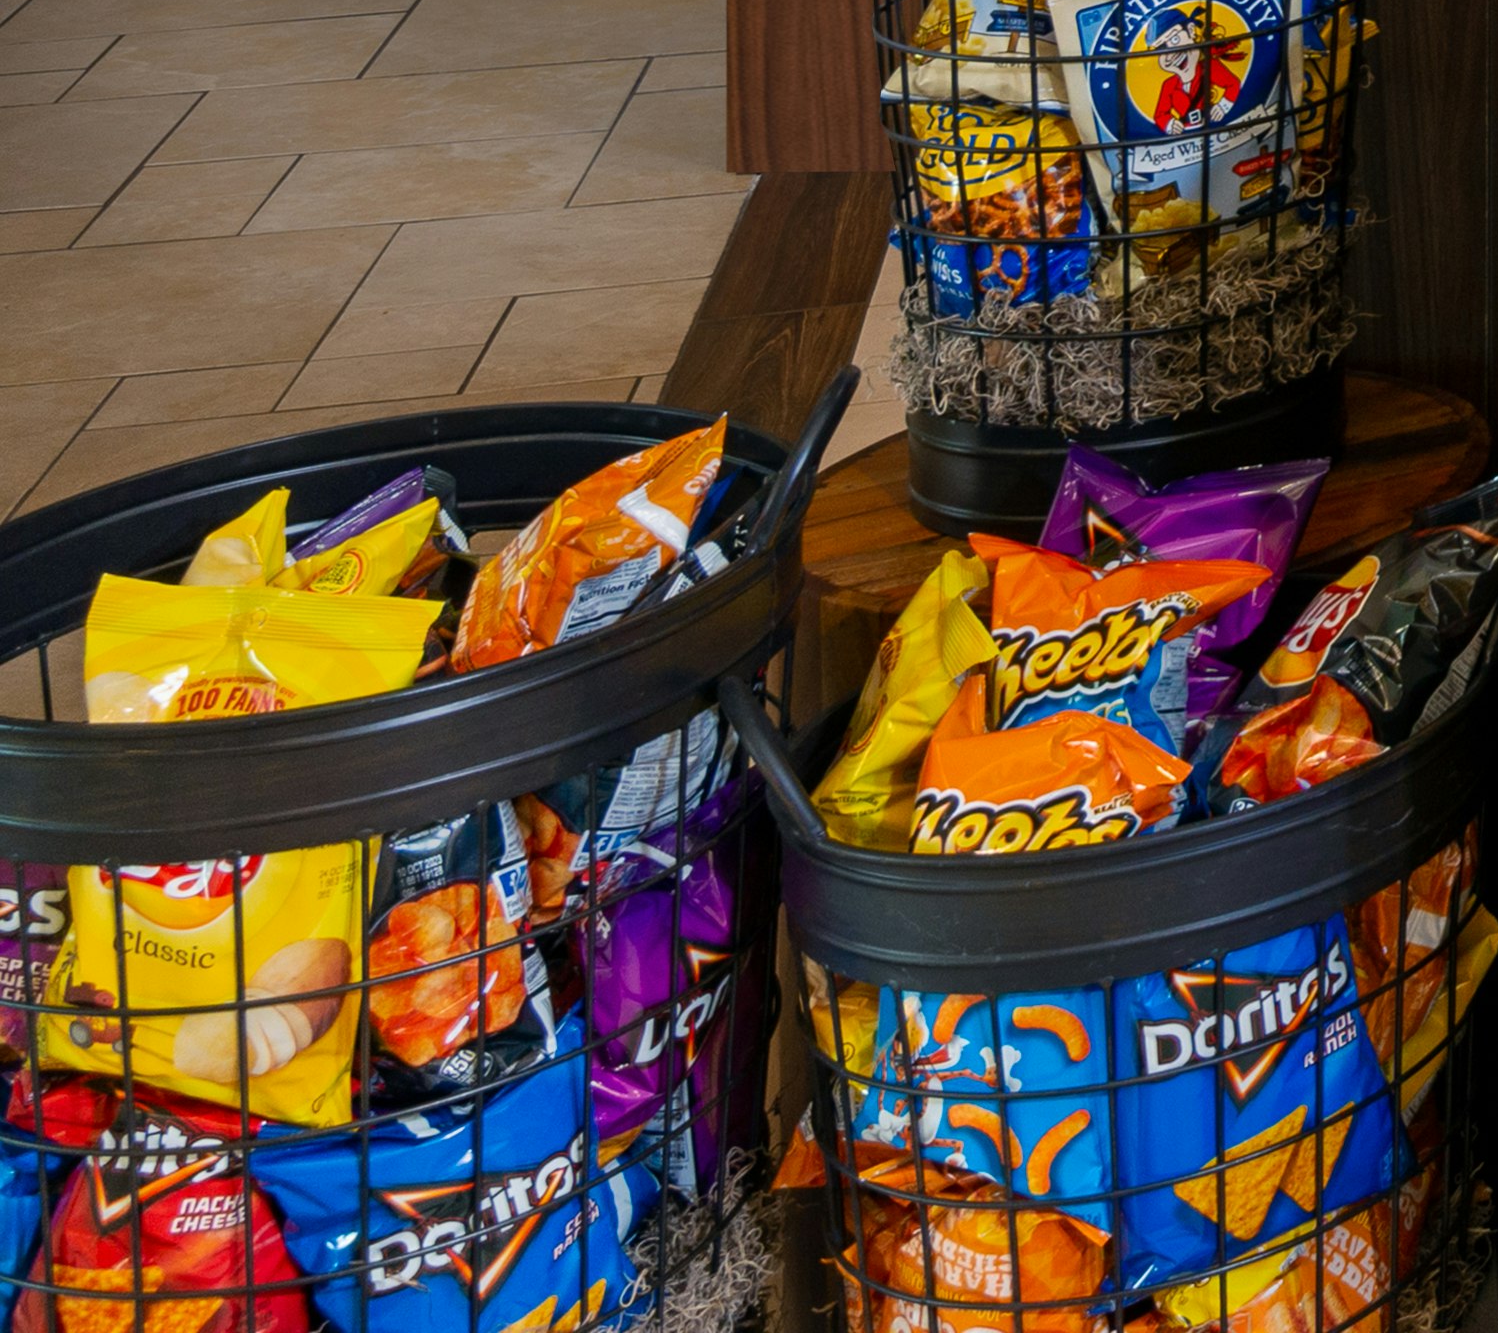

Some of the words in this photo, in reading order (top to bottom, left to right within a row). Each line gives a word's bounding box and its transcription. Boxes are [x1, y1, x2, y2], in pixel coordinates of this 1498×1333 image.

[918, 133, 1018, 173] GOLD
[175, 691, 221, 718] 100
[114, 931, 216, 971] Classic
[1144, 942, 1347, 1076] Doritos
